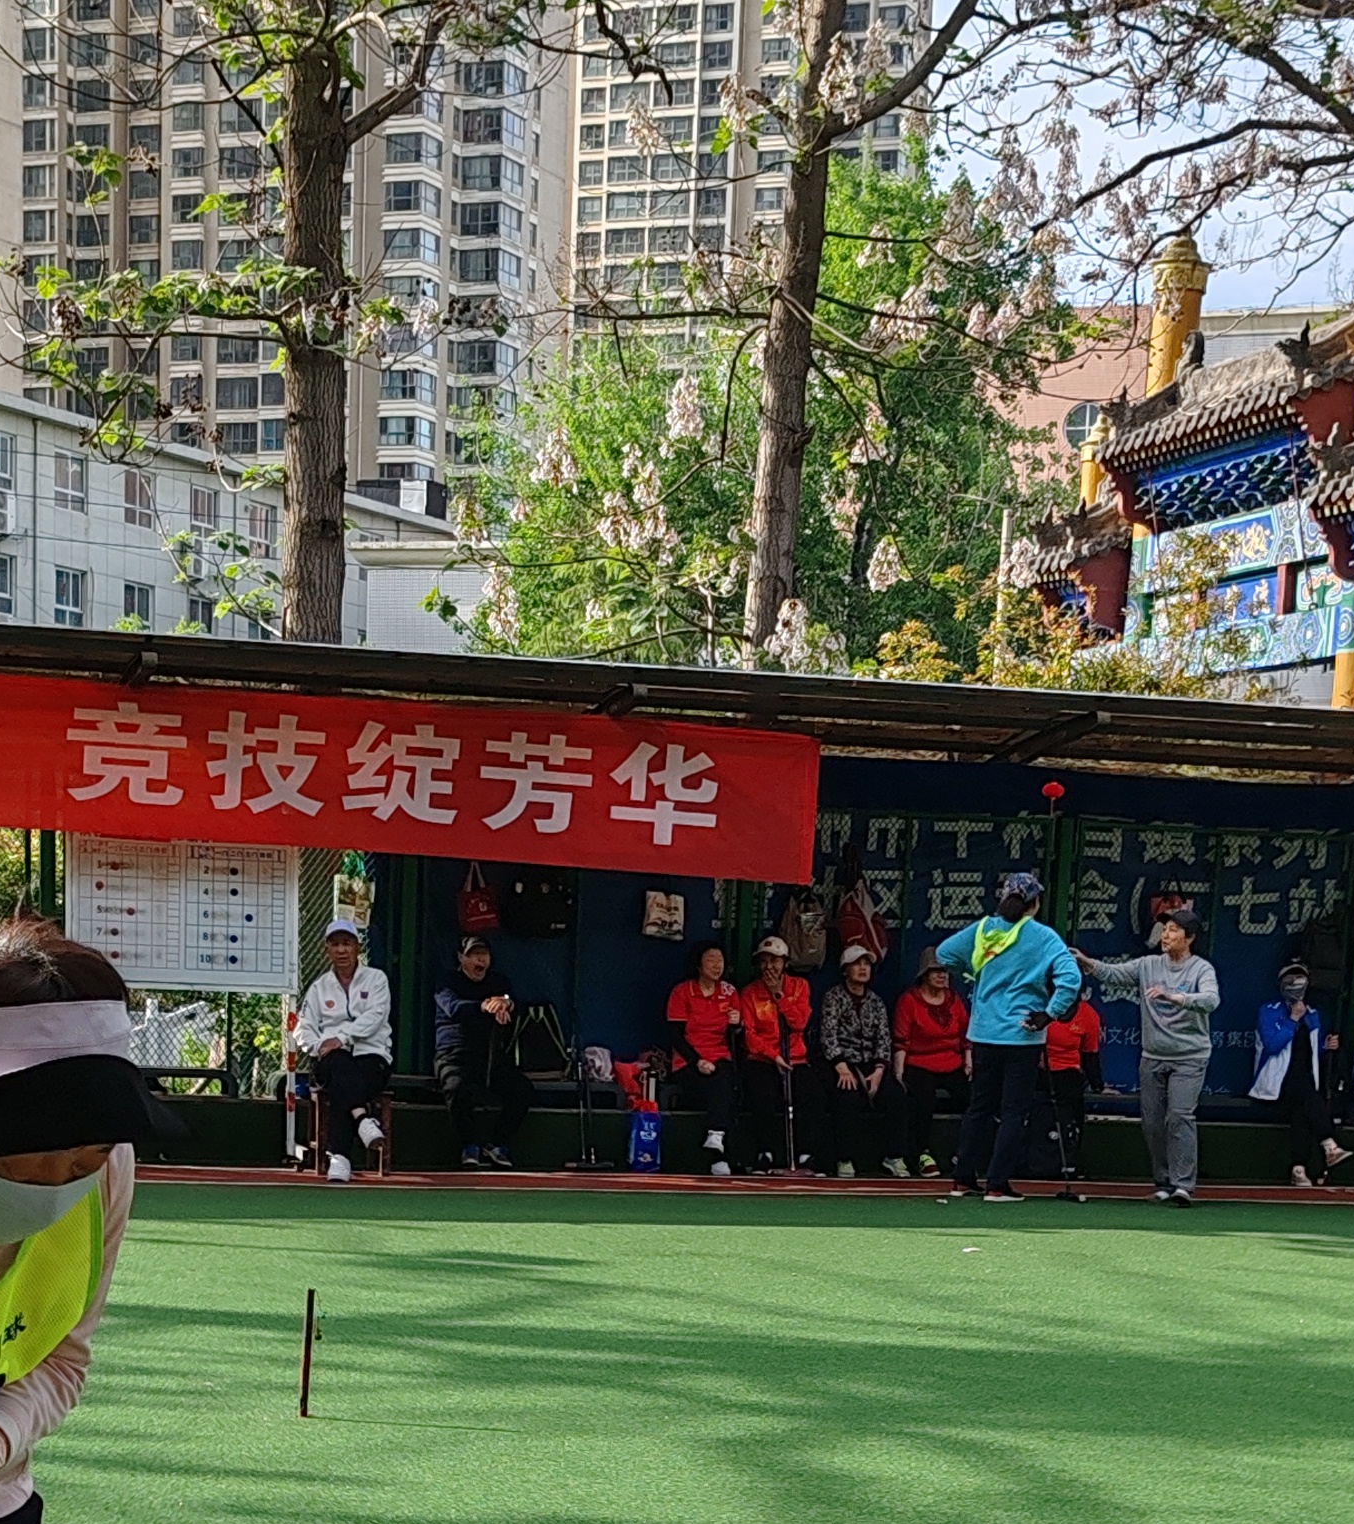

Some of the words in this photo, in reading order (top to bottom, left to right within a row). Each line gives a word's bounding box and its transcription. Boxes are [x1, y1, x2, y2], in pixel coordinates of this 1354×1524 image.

[65, 702, 719, 846] 竞技绽芳华
[203, 865, 210, 875] 2
[203, 888, 210, 896] 4
[203, 910, 210, 919] 6
[95, 927, 103, 937] 7
[202, 932, 210, 942] 8
[199, 954, 212, 965] 10
